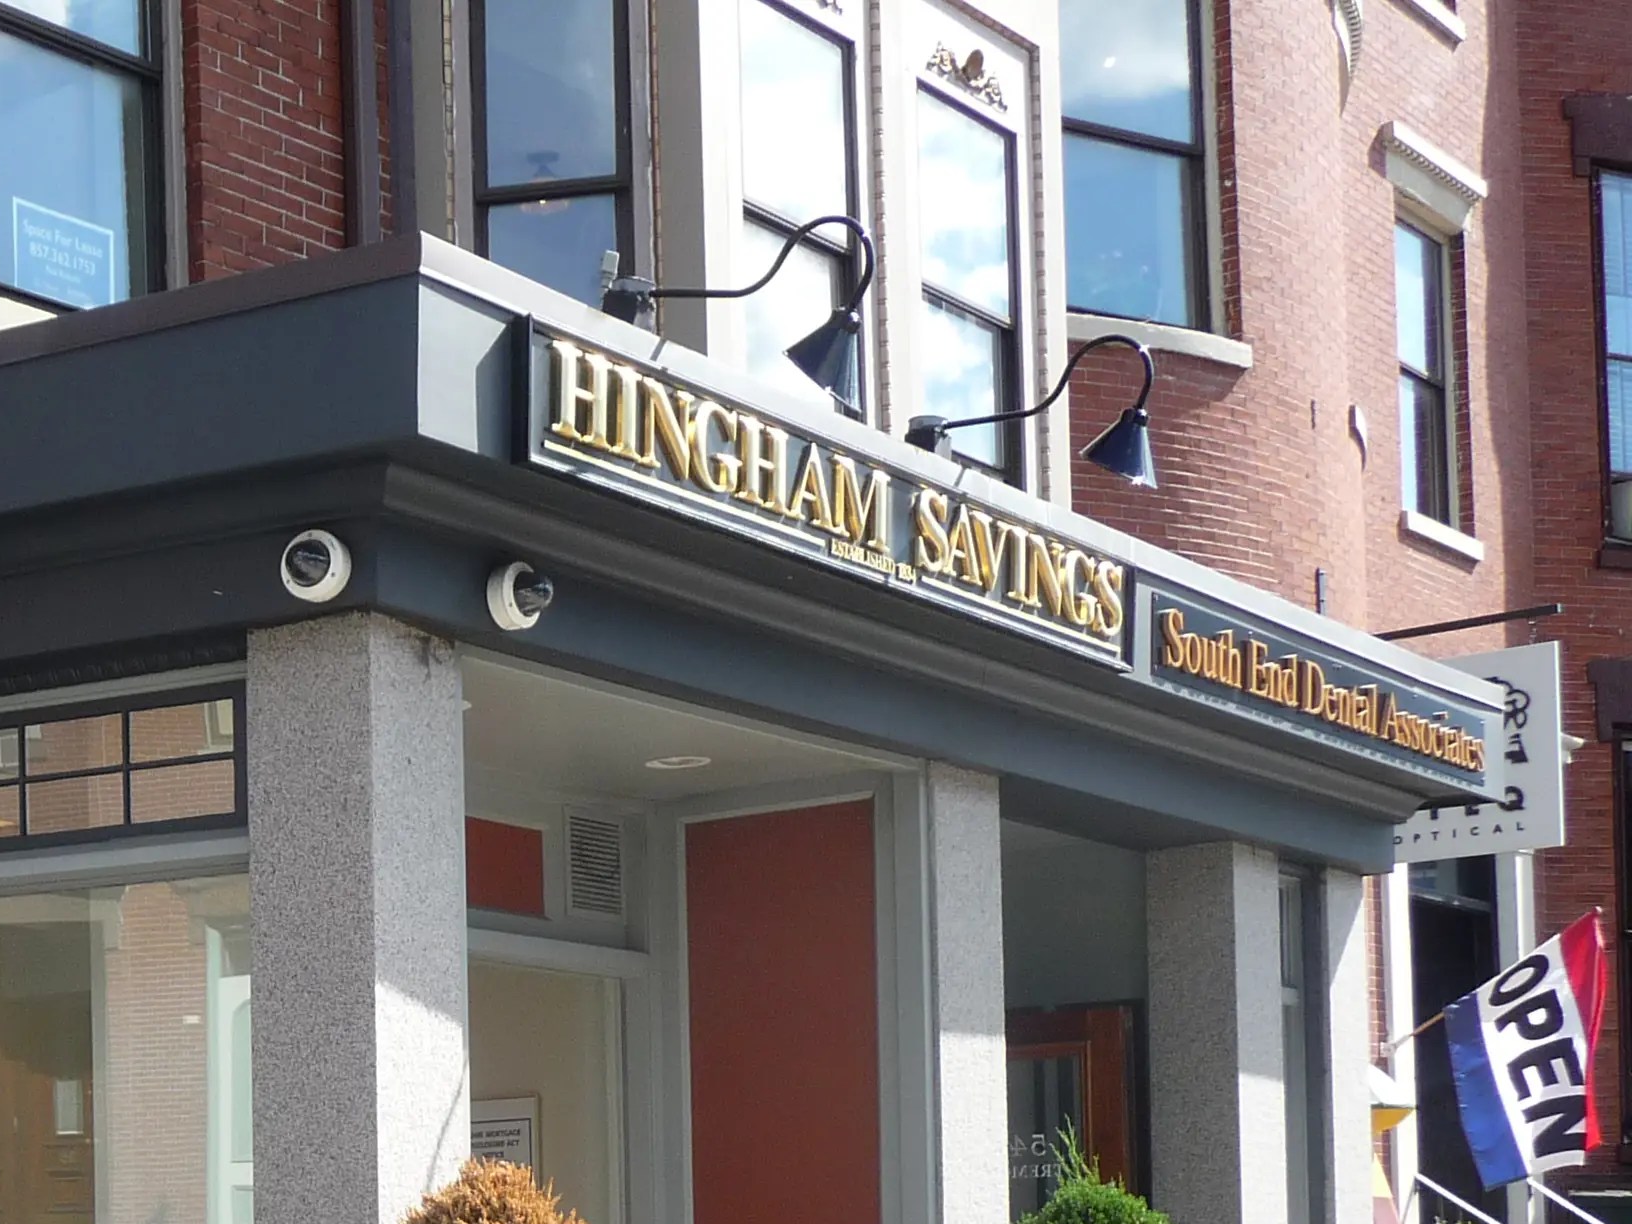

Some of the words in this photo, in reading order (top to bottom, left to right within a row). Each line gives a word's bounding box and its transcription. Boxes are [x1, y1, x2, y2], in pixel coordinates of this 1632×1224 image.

[22, 217, 53, 242] Space
[54, 228, 73, 248] For
[549, 339, 892, 553] HINGHAM
[912, 484, 1124, 638] SAVINGS
[830, 537, 895, 577] ESTABLISHED
[1160, 607, 1242, 688] South
[1249, 640, 1298, 708] End
[1303, 661, 1378, 737] Dental
[1383, 688, 1486, 775] Associates
[1393, 821, 1527, 845] OPTICAL
[1488, 951, 1589, 1160] OPEN
